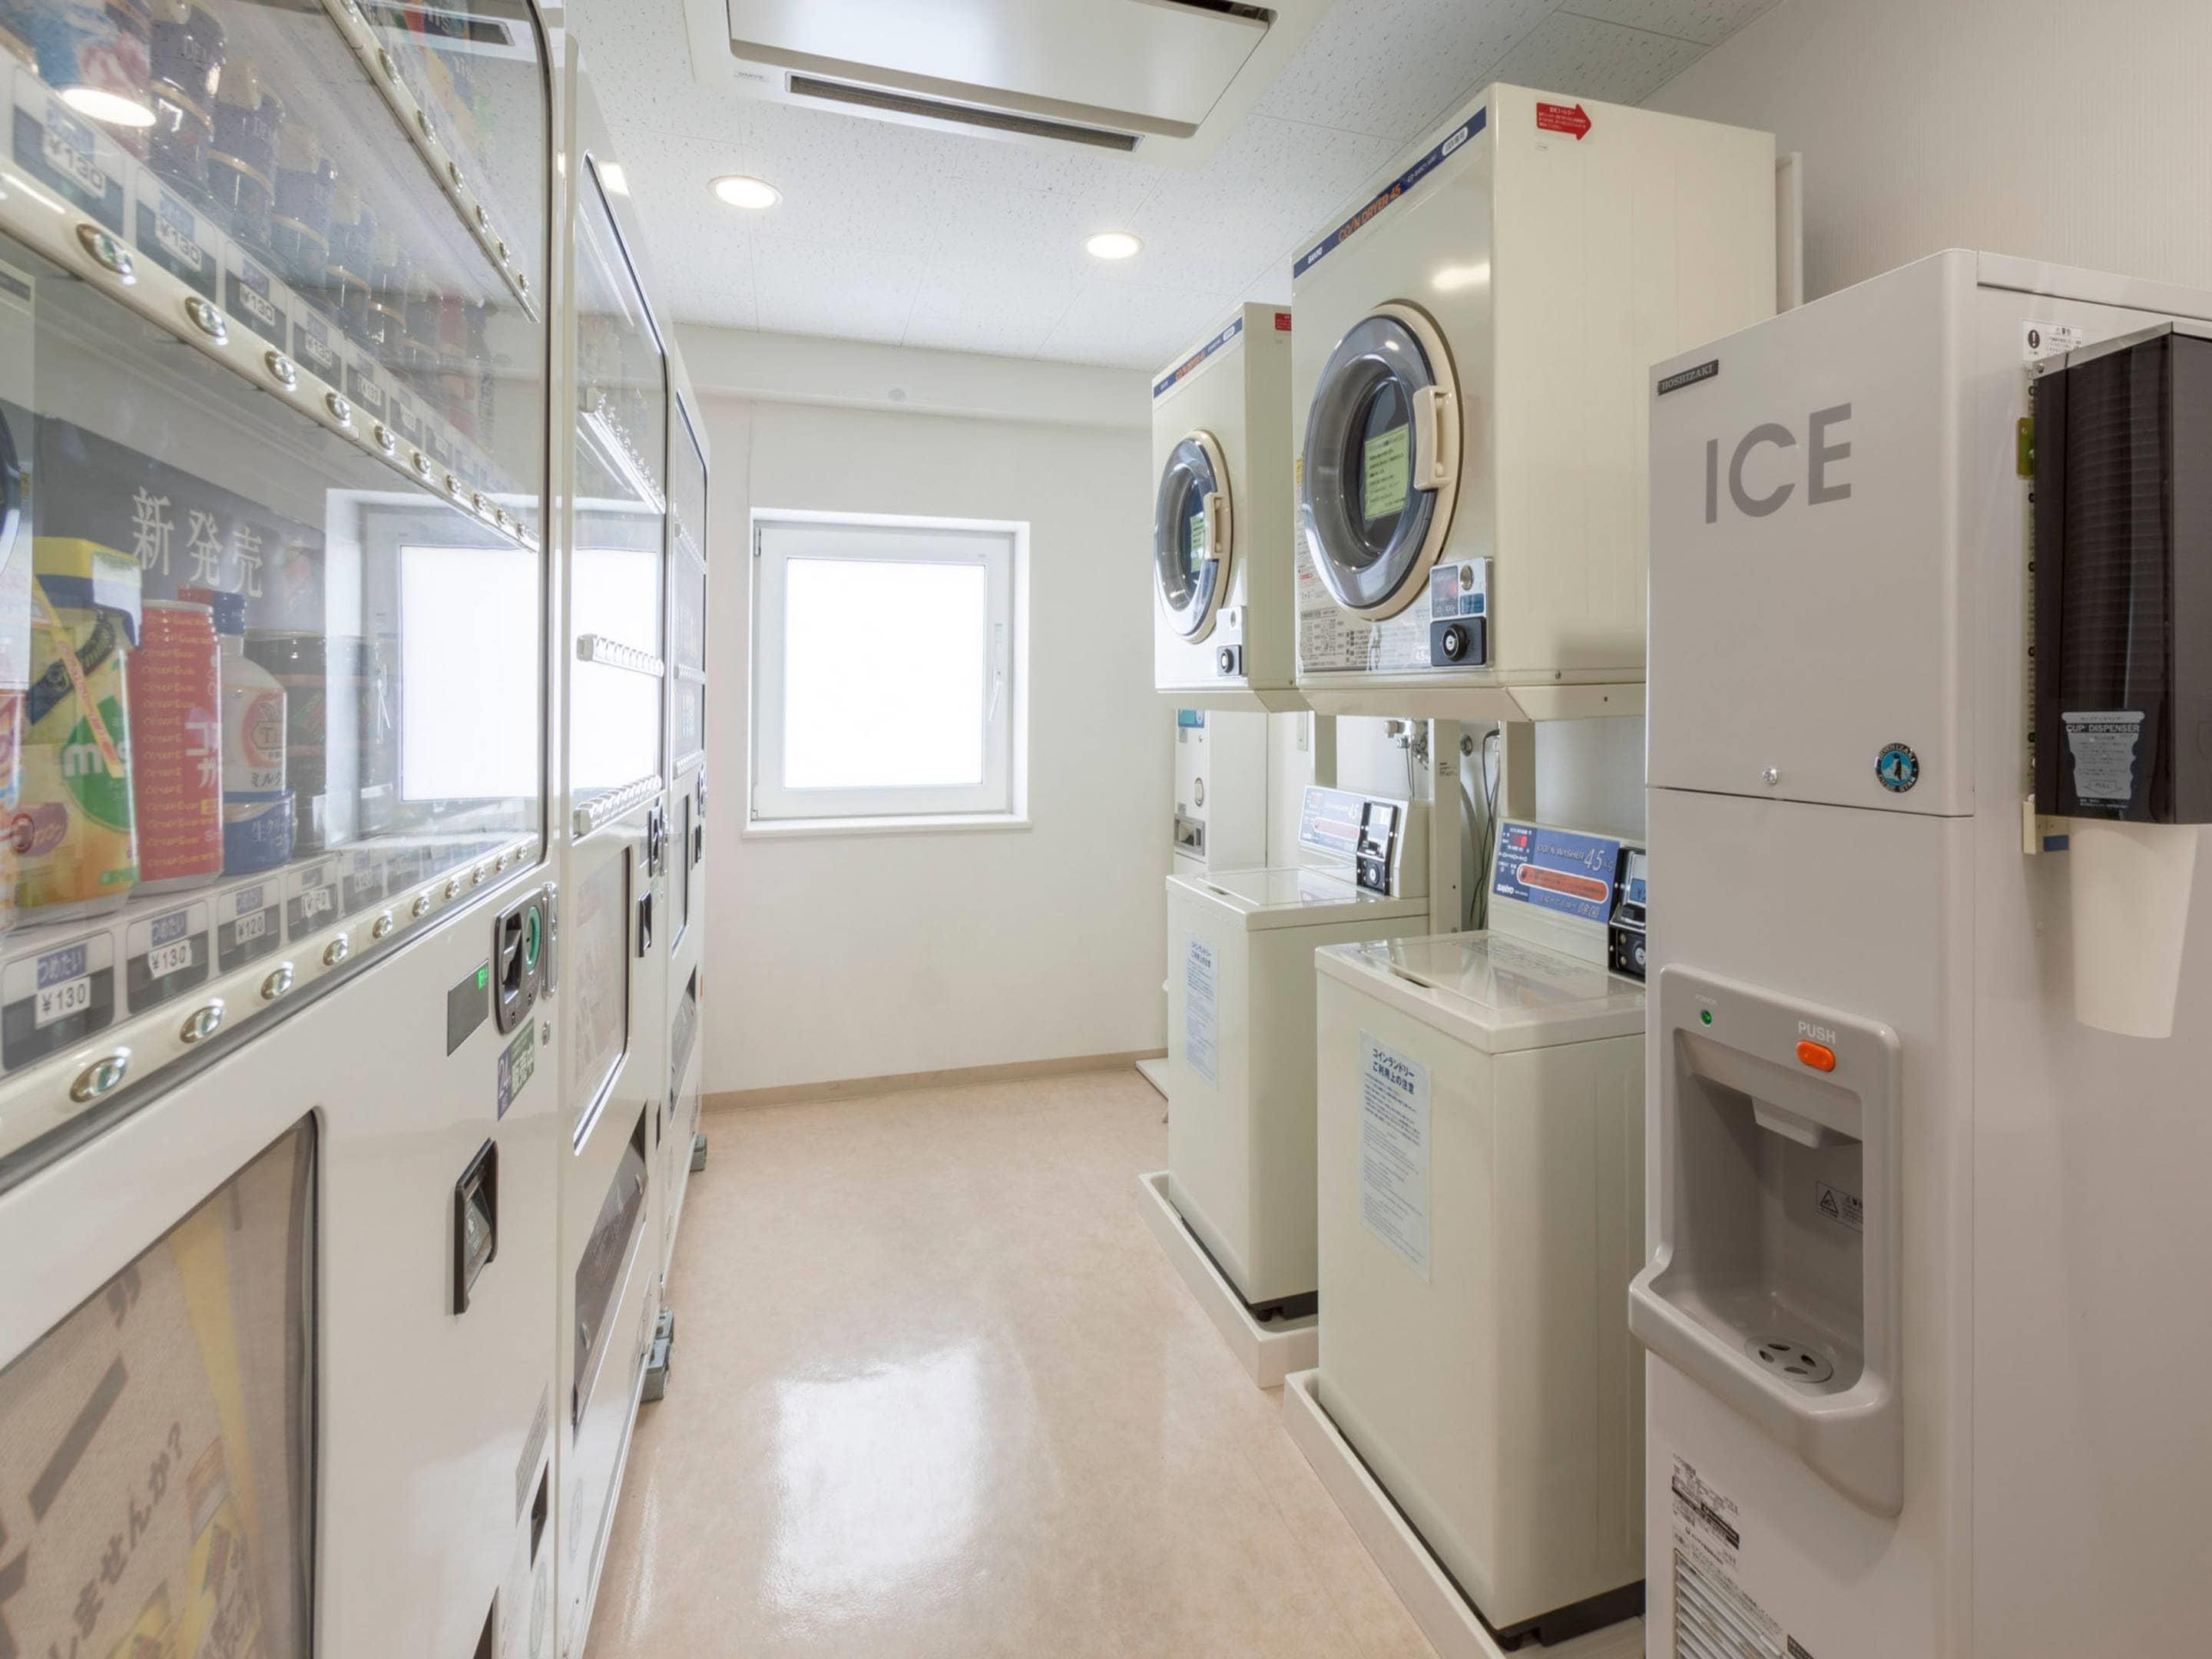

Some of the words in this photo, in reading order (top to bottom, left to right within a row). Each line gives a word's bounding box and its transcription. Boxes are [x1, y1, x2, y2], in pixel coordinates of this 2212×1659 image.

[1361, 194, 1389, 224] DRYER
[1661, 364, 1714, 392] HOSHIZAKI
[1705, 402, 1852, 525] ICE
[131, 485, 264, 599] 新発売
[2065, 724, 2085, 733] CUP
[2088, 724, 2141, 733] DISPENSER
[1556, 846, 1585, 861] WASHER
[152, 945, 187, 970] ¥130
[41, 982, 87, 1016] ¥130
[1797, 1021, 1836, 1045] PUSH
[1373, 1048, 1415, 1078] コインランドリー
[1373, 1061, 1415, 1095] ご利用上の注意
